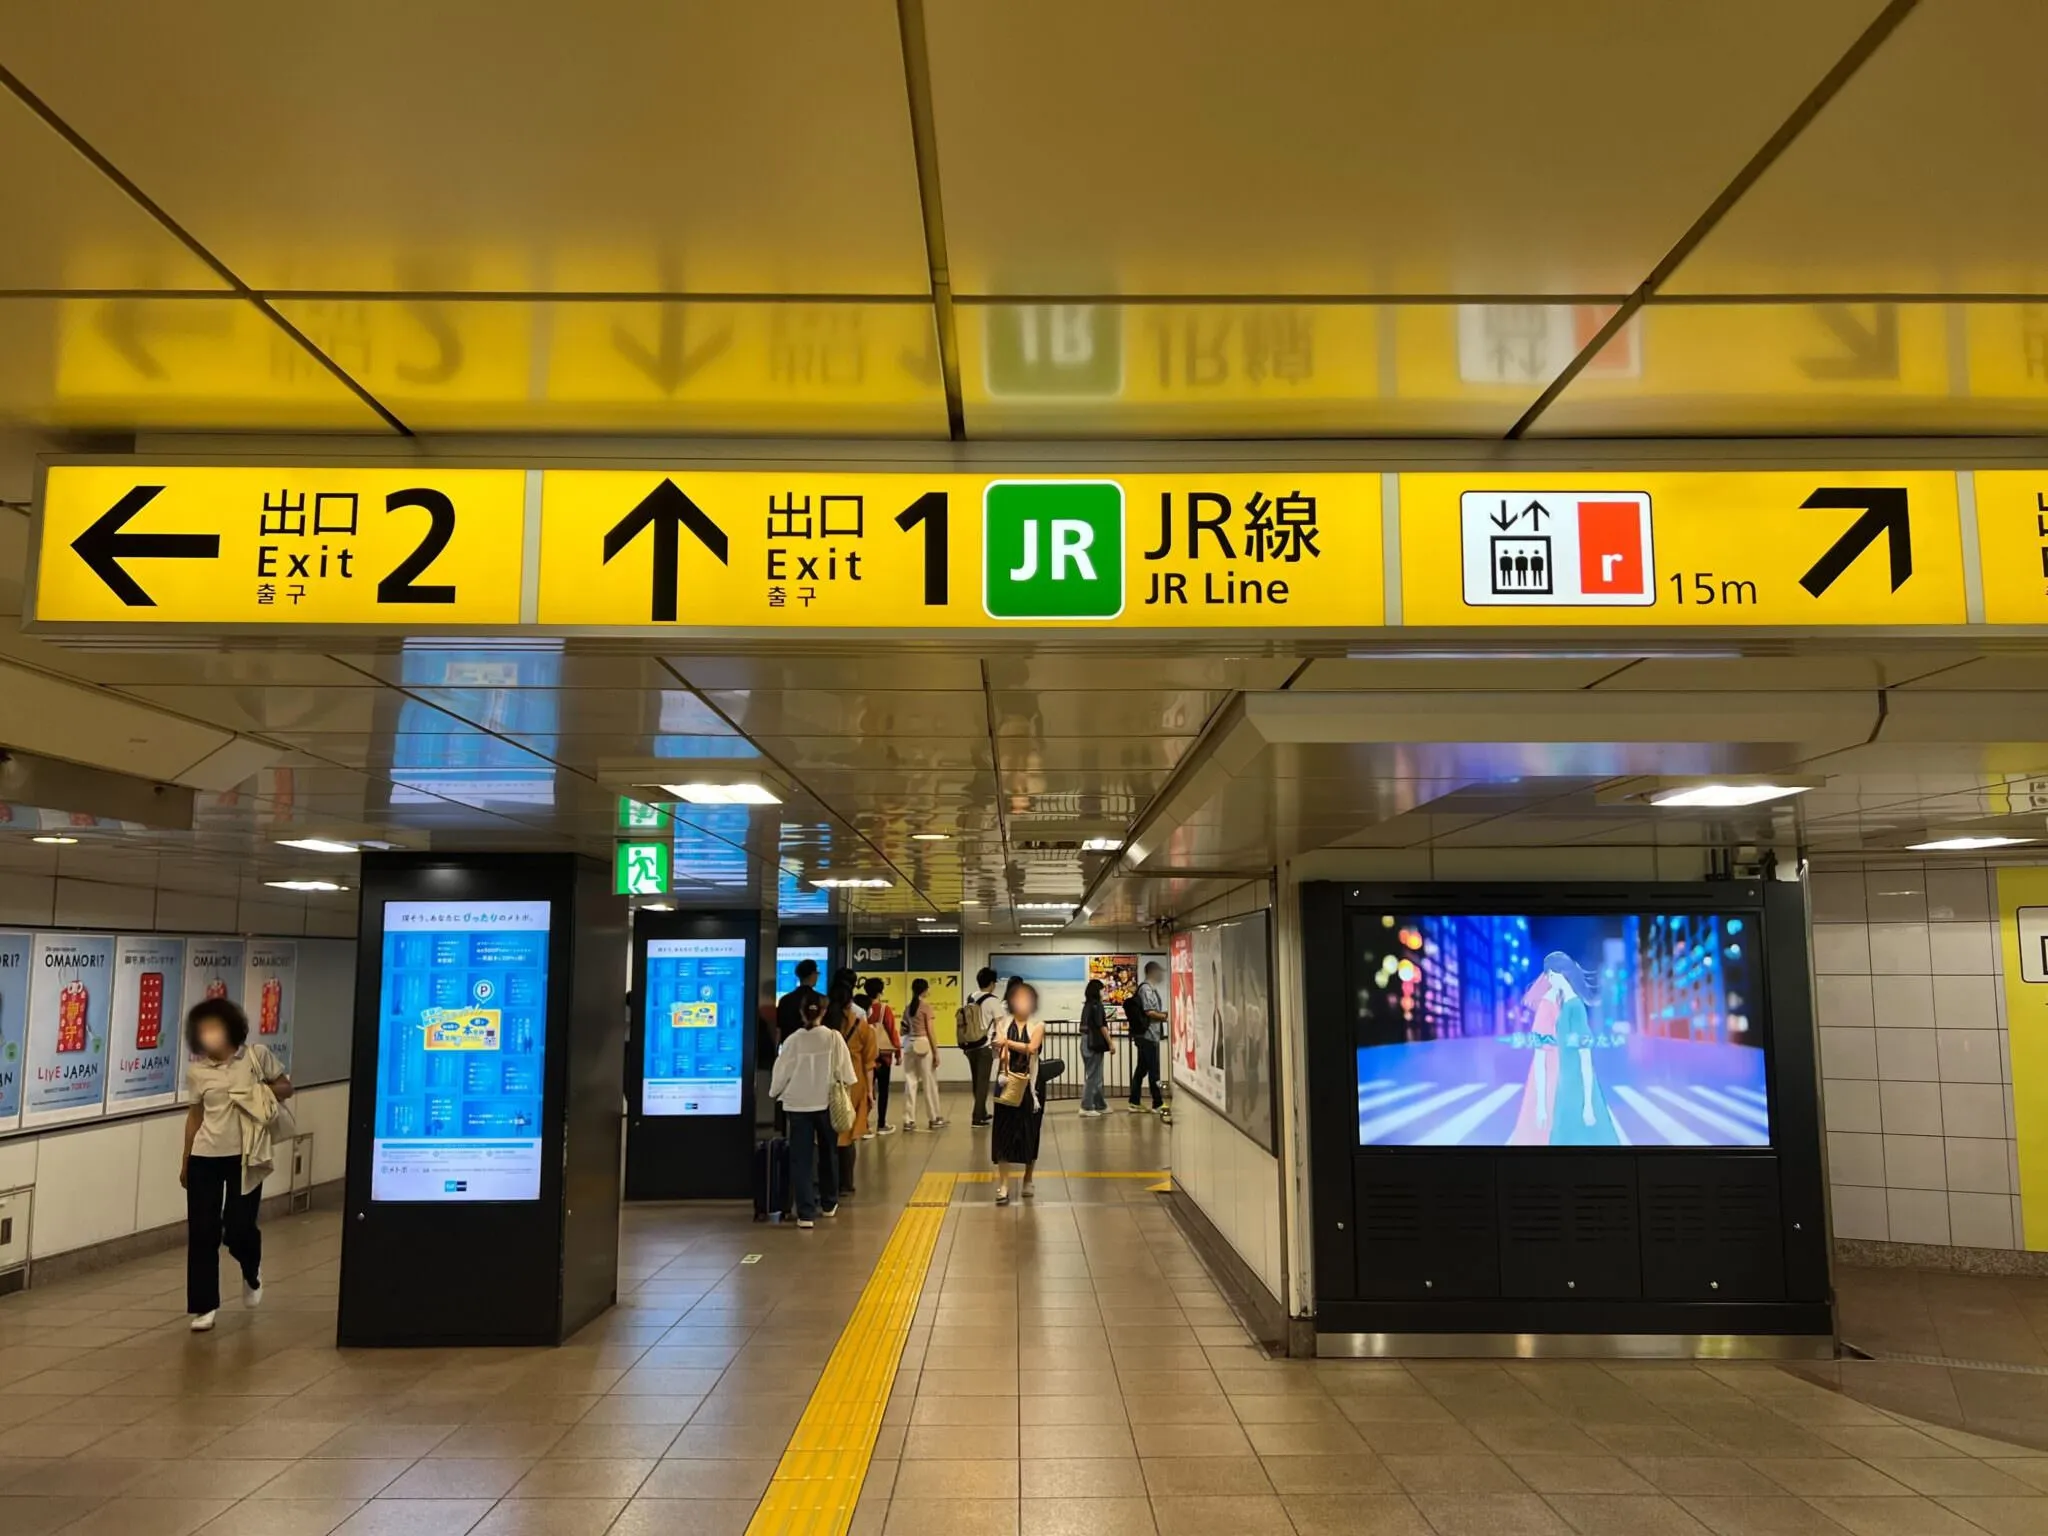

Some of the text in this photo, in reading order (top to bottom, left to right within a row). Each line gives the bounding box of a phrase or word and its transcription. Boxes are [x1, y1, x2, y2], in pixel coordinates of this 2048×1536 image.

[260, 490, 358, 536] 出口
[768, 492, 863, 539] 出口
[1144, 491, 1320, 562] JR線
[258, 546, 352, 577] Exit
[378, 489, 455, 603] 2
[895, 493, 947, 605] 1
[1011, 520, 1097, 580] JR
[768, 548, 861, 580] Exit
[1145, 572, 1289, 604] JR Line
[1671, 573, 1758, 605] 15m
[45, 954, 105, 967] OMAMORI?
[38, 1063, 98, 1081] LIVE JAPAN
[120, 1055, 170, 1073] LIVE JAPAN
